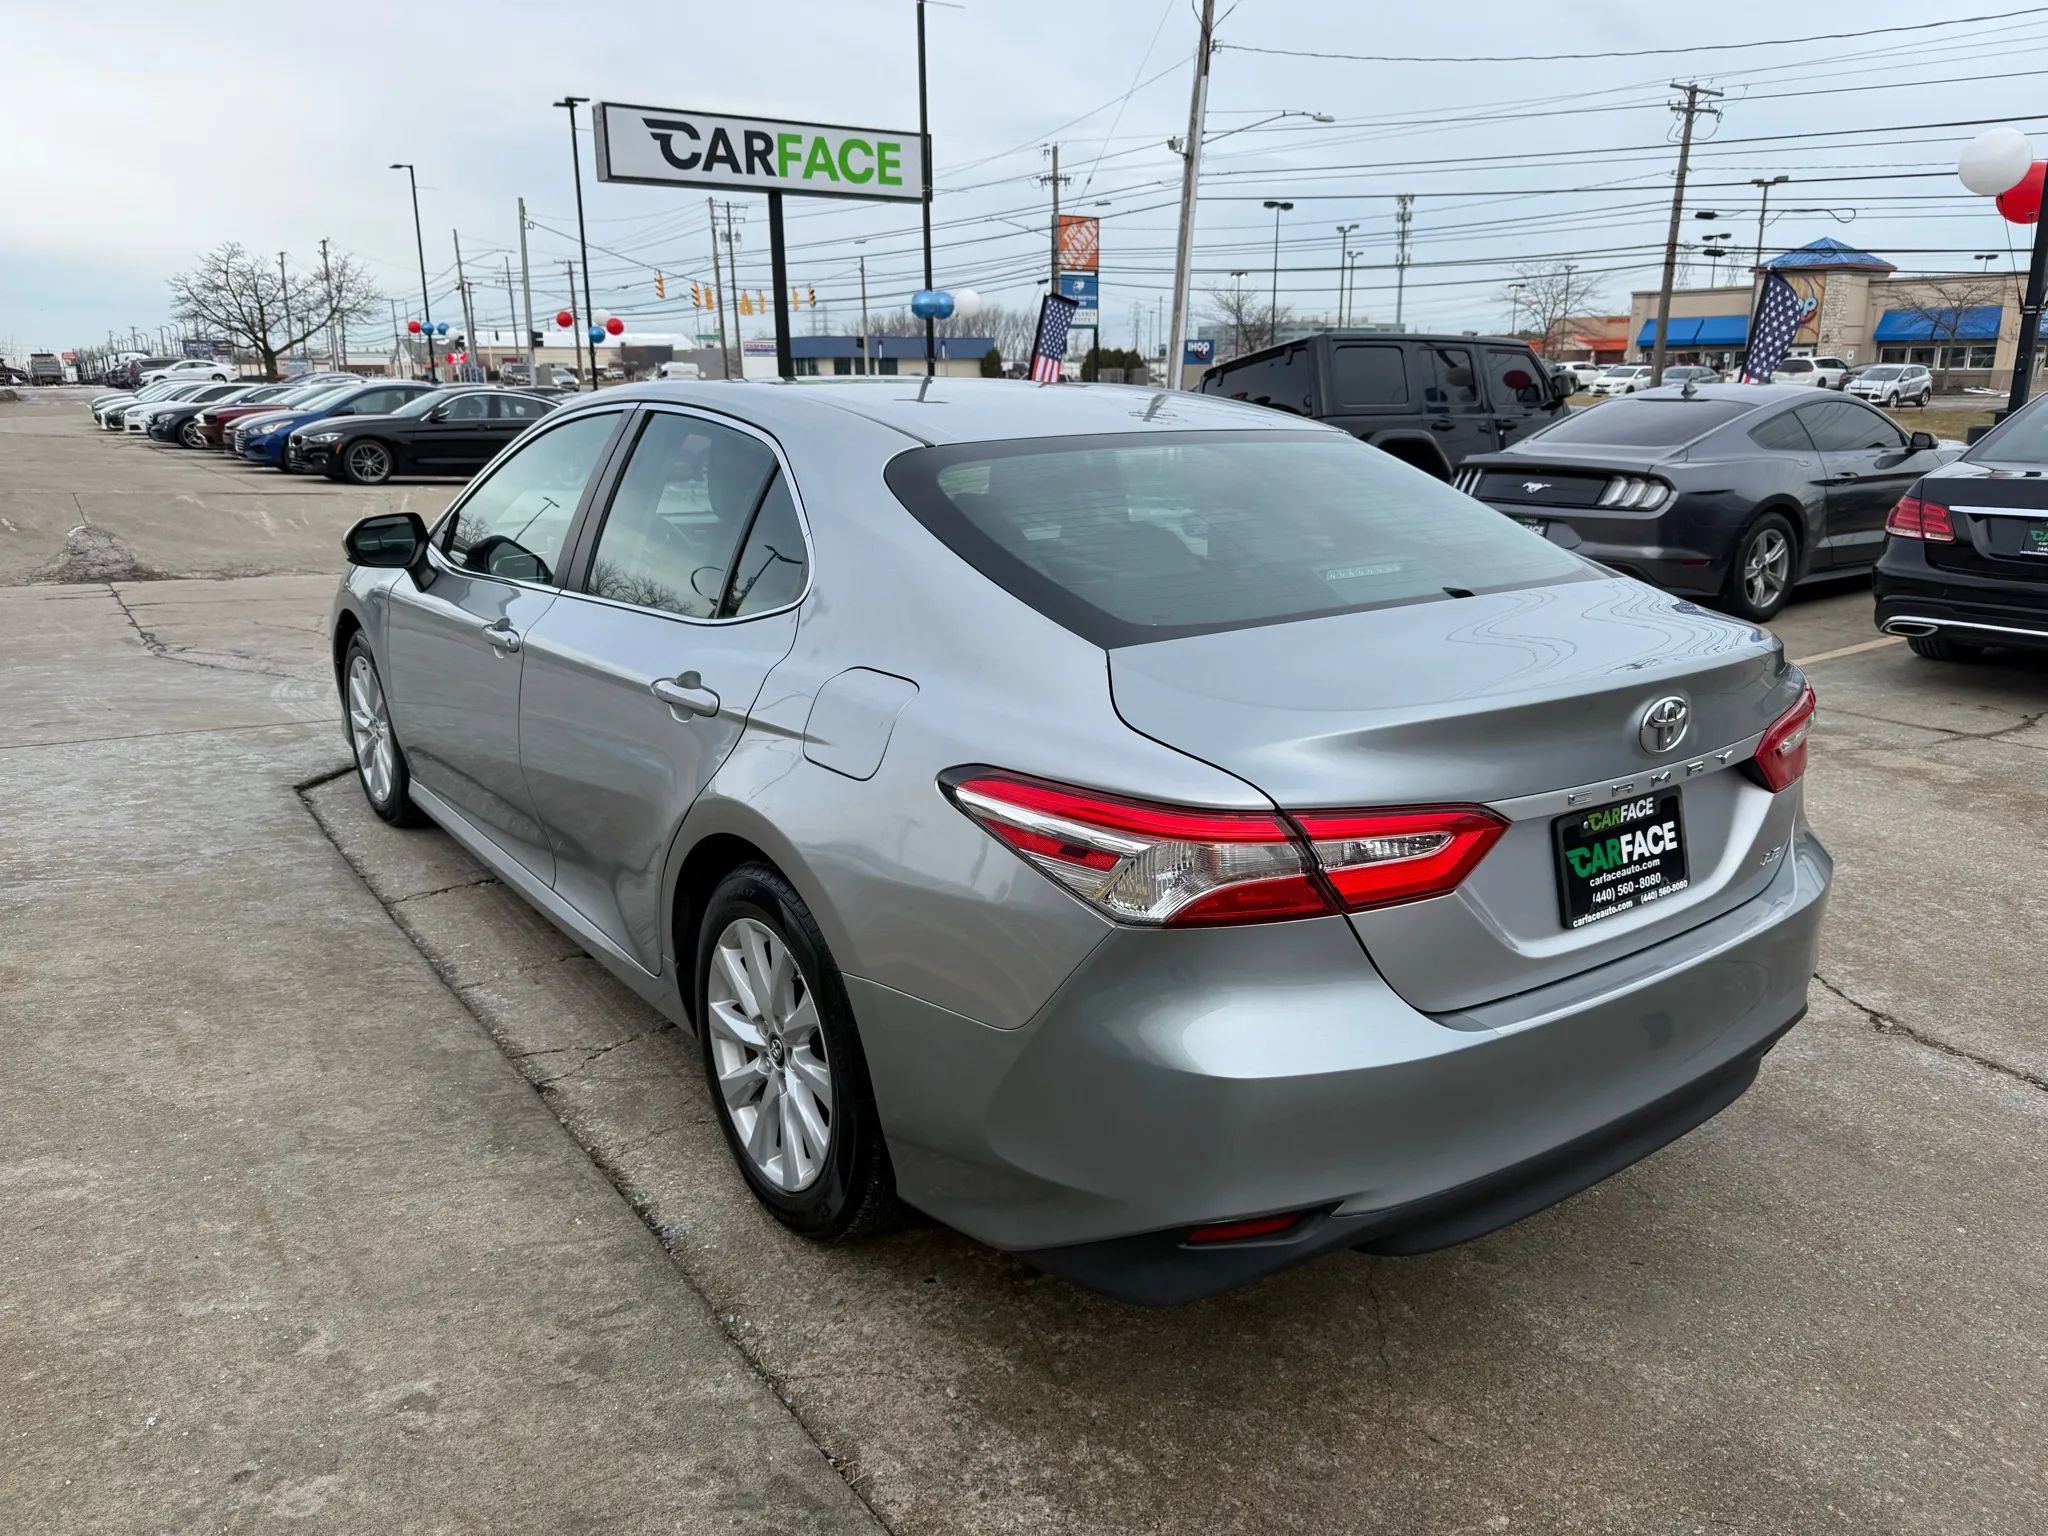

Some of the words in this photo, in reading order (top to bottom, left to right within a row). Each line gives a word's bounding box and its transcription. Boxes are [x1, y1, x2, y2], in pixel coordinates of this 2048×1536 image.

[641, 117, 903, 186] CARFACE
[1567, 750, 1733, 806] CAMRY
[1588, 797, 1654, 832] CARFACE
[1566, 821, 1678, 878] CARFACE
[1589, 857, 1661, 887] carfaceauto.com
[1592, 886, 1615, 904] (440)
[1640, 890, 1658, 905] (440)
[1572, 900, 1633, 928] carfaceauto.com
